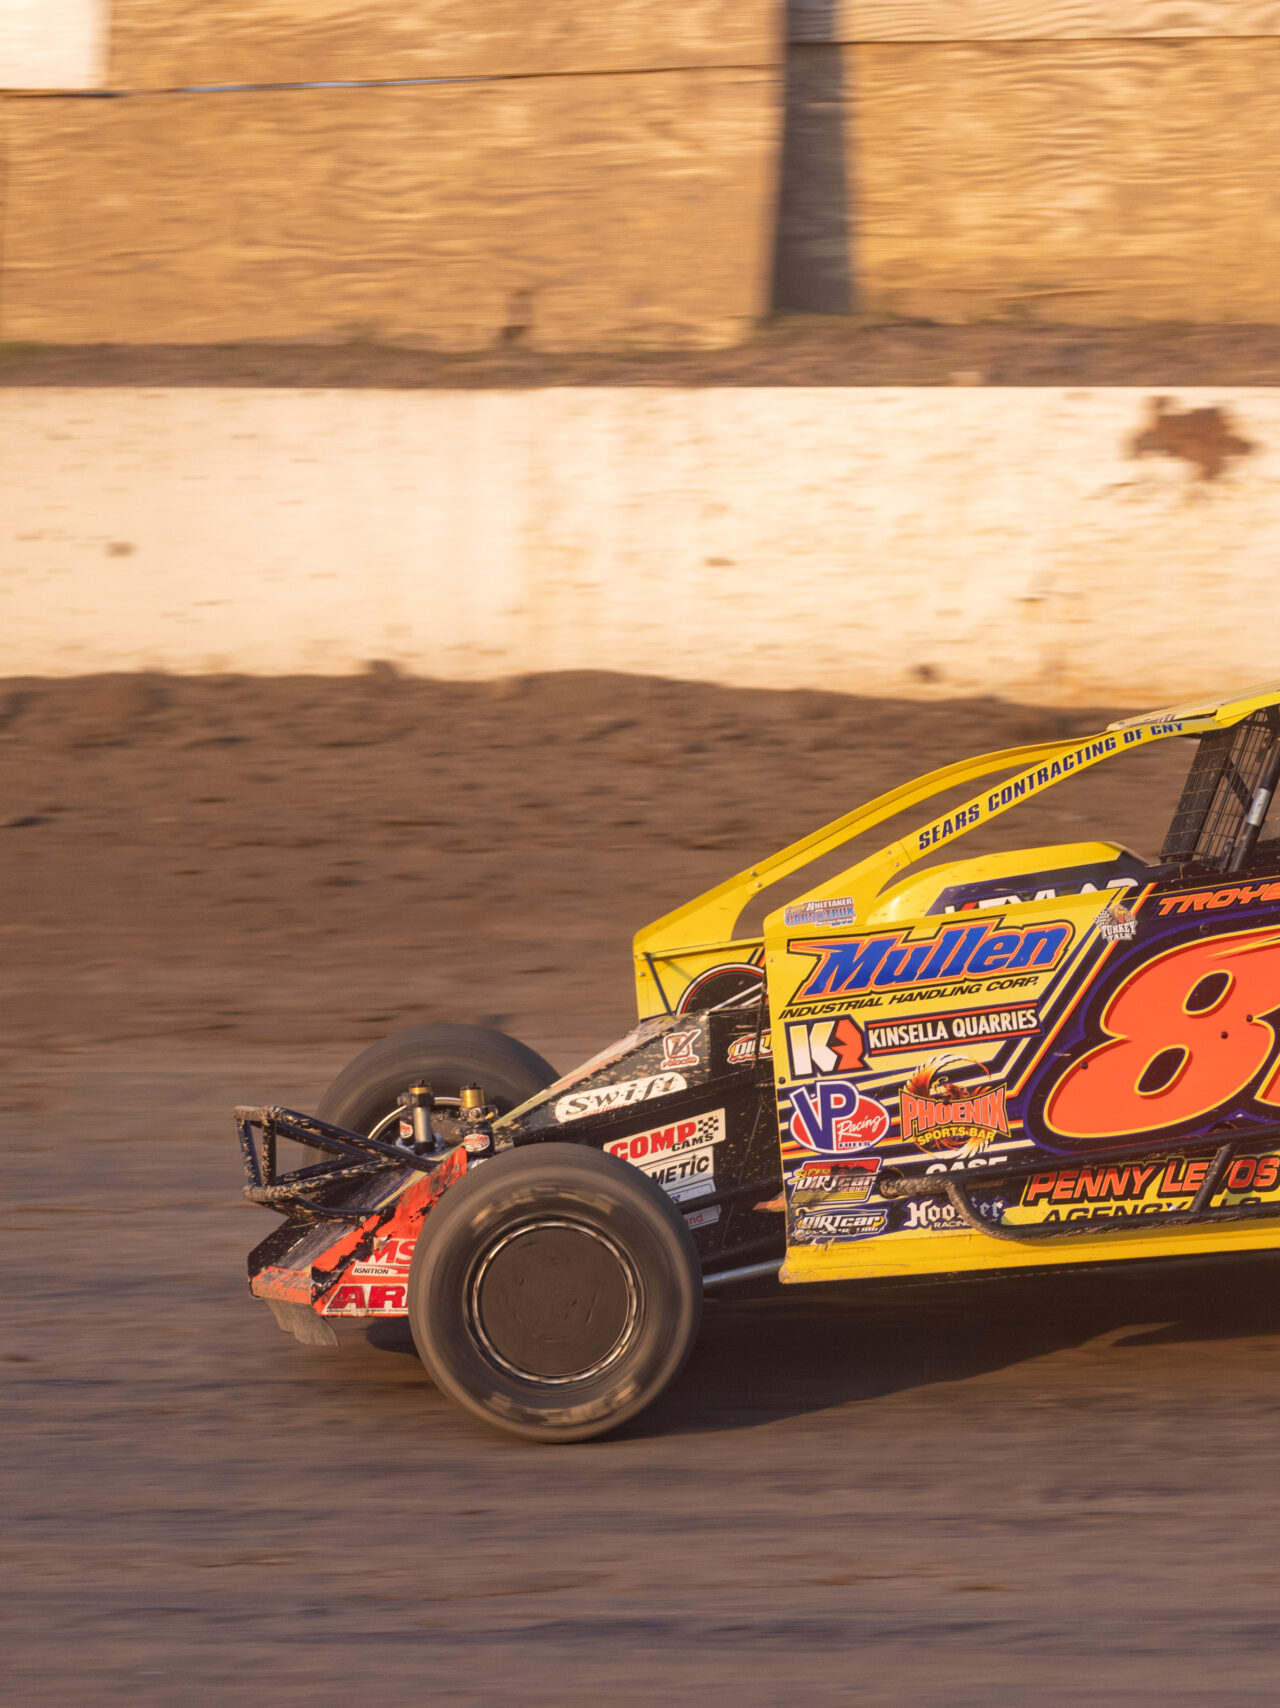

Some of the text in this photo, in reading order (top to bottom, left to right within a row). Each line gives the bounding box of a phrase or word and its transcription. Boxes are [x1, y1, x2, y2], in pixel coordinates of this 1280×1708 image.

[918, 721, 1183, 851] SEARS CONTRACTING OF CNY
[1100, 920, 1137, 938] TURKEY
[1106, 932, 1133, 943] TALK
[797, 924, 1071, 997] Mullen
[778, 976, 1039, 1020] INDUSTRIAL HANDLING CORP.
[868, 1009, 1038, 1049] KINSELLA QUARRIES
[565, 1075, 676, 1116] Swift
[901, 1086, 1009, 1141] PHOENIX
[791, 1081, 857, 1151] VP
[836, 1114, 887, 1142] Racing
[609, 1121, 698, 1161] COMP
[671, 1132, 714, 1152] CAMS
[916, 1126, 996, 1146] SPORTS BAR
[788, 1168, 831, 1184] SUPER
[1026, 1156, 1280, 1201] PENNY LEOS
[903, 1196, 1004, 1228] Hooer
[354, 1267, 389, 1275] IGNITION
[326, 1285, 409, 1310] AR
